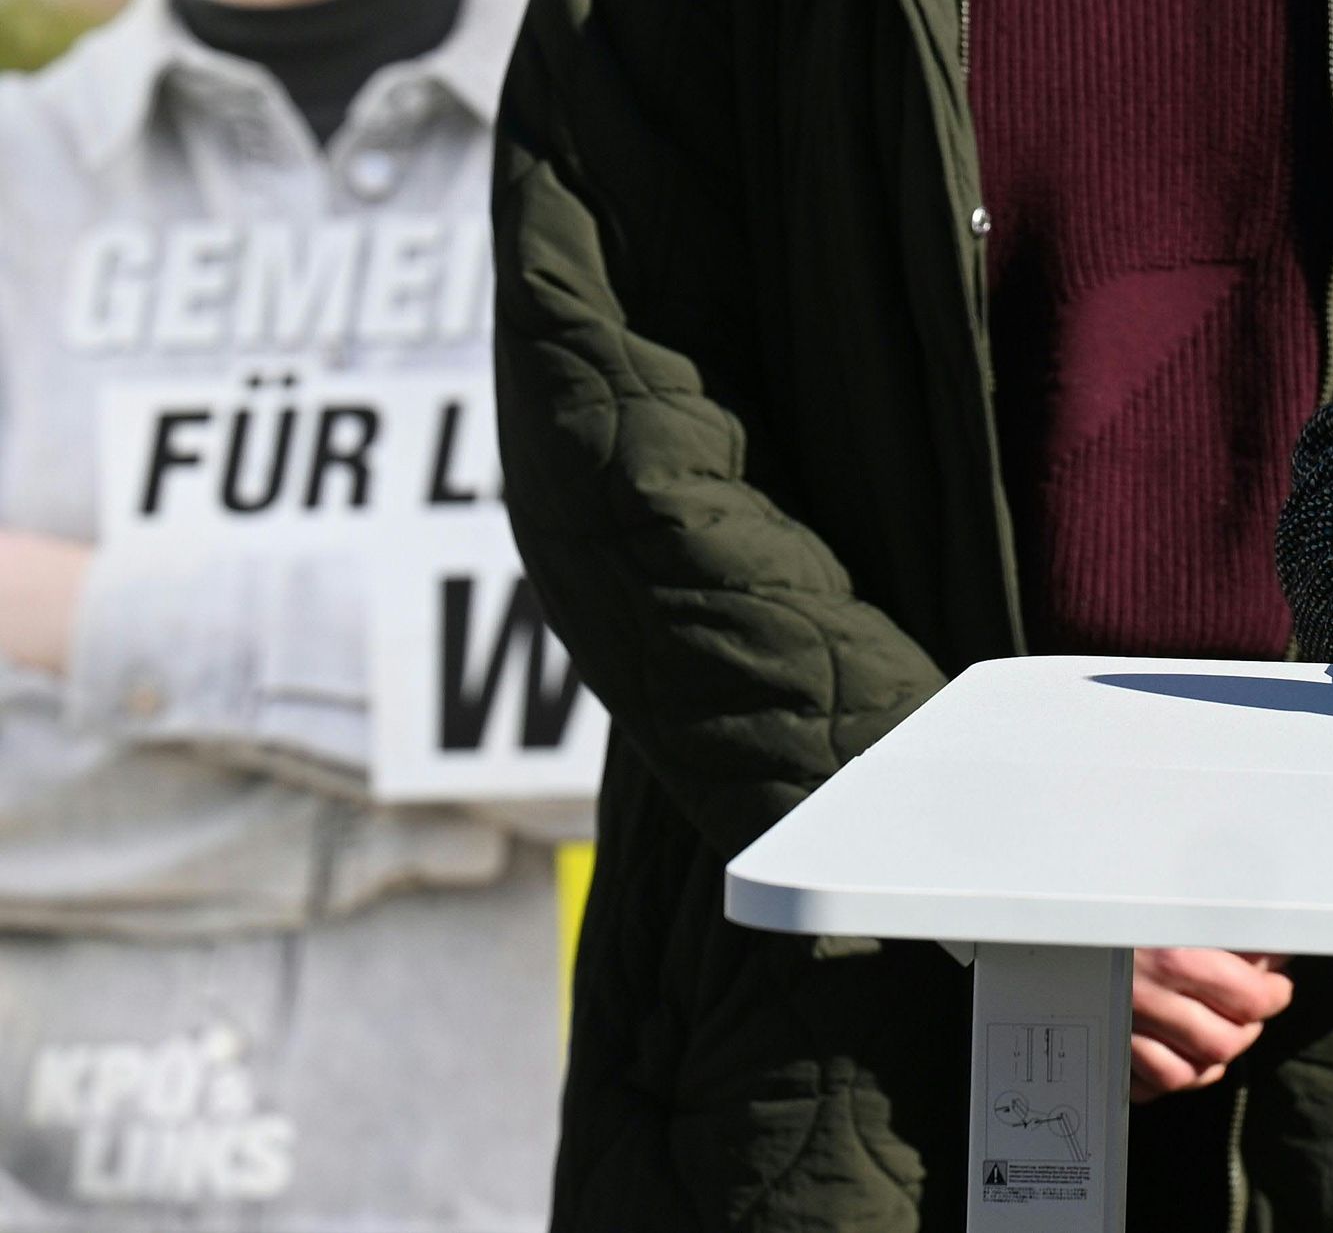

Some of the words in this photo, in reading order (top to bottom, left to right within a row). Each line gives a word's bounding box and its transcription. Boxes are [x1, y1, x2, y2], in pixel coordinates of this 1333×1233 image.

[64, 219, 488, 349] GEMEI
[136, 371, 382, 517] FÜR
[422, 397, 508, 507] L
[437, 573, 582, 753] W
